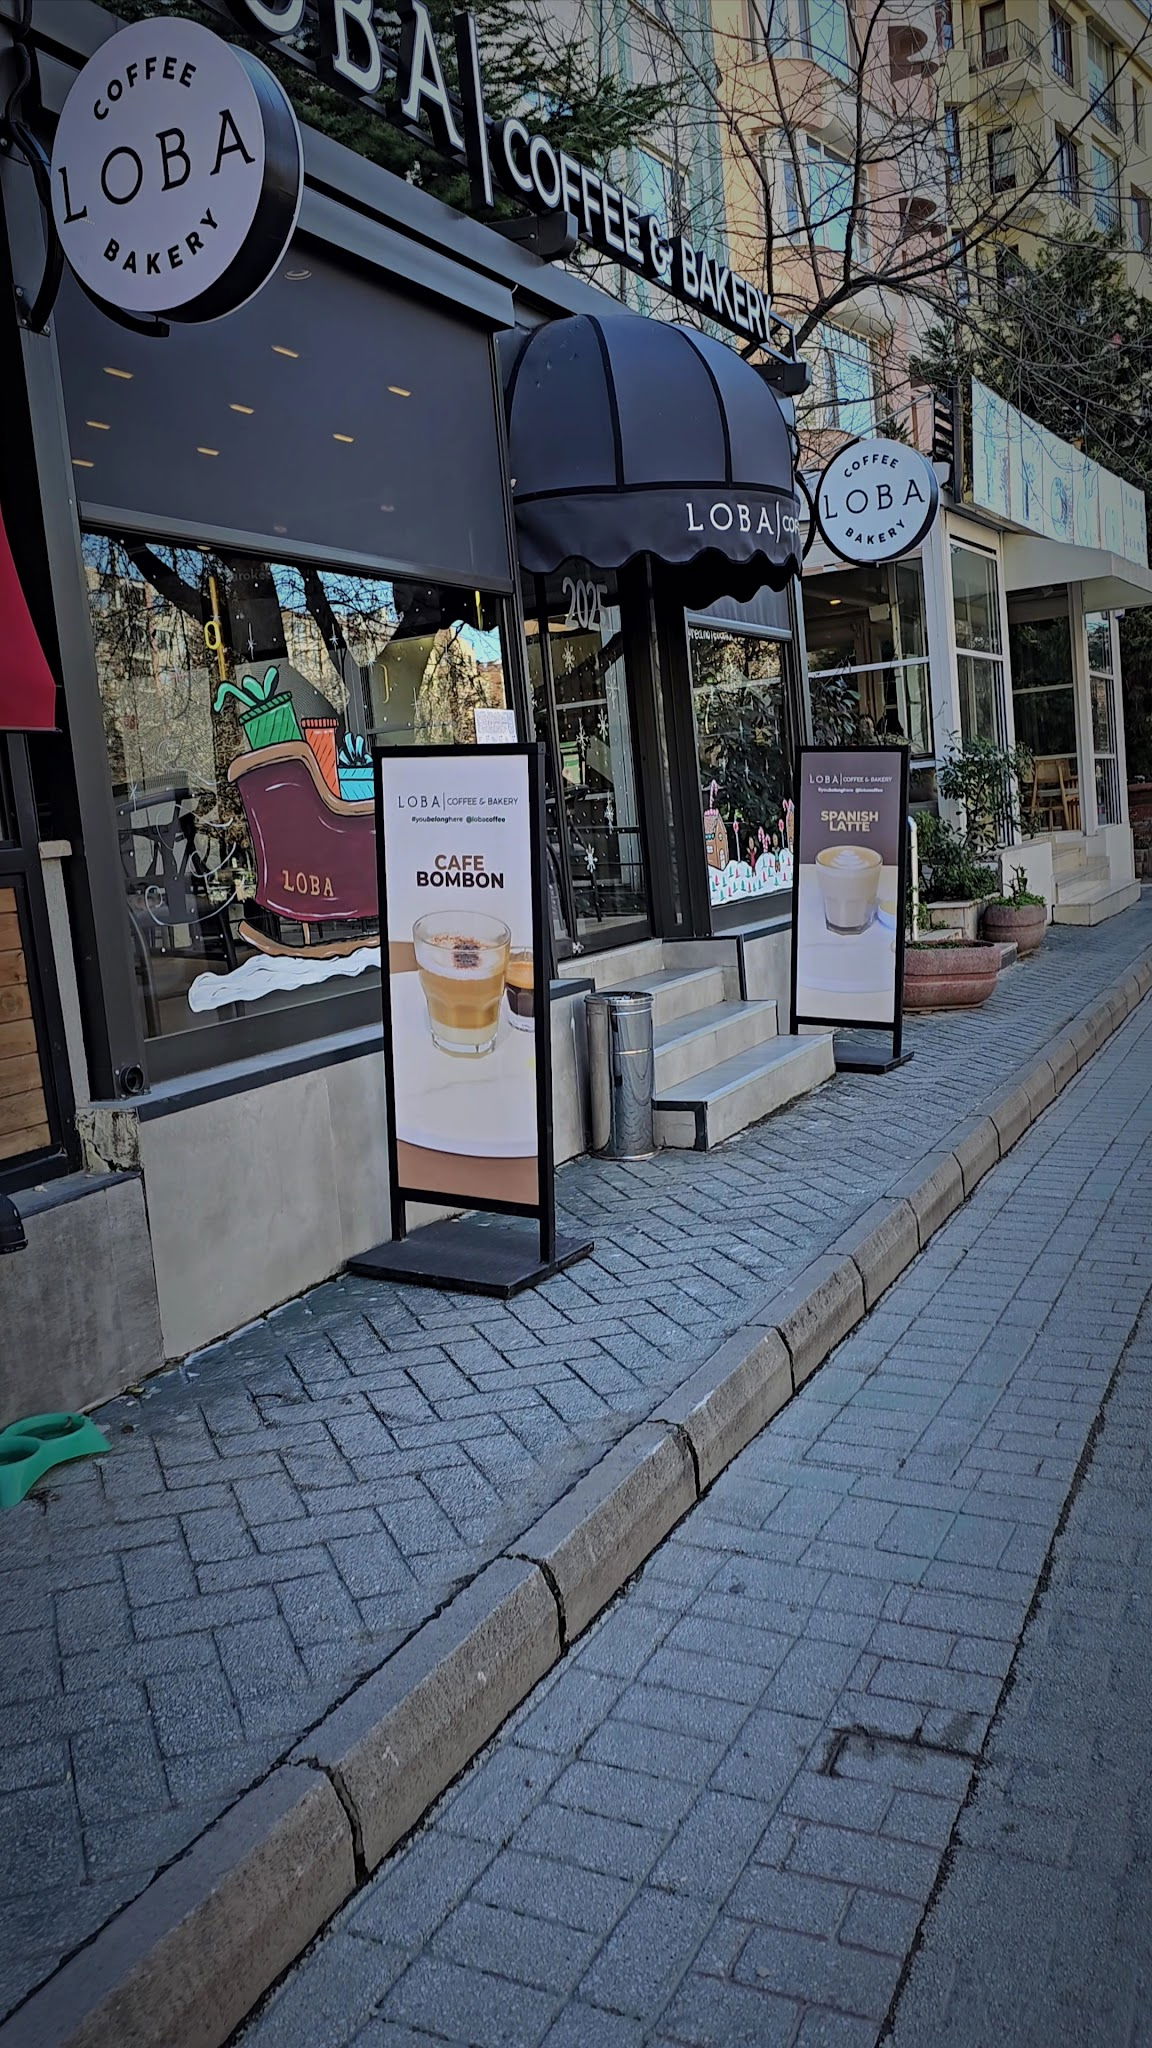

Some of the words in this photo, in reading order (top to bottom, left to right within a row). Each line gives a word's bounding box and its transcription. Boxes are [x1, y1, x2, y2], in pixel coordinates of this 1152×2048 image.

[93, 55, 197, 121] COFFEE
[57, 108, 256, 225] LOBA
[244, 0, 466, 153] BA
[502, 116, 645, 265] COFFEE
[649, 213, 673, 275] &
[680, 235, 772, 342] BAKERY
[103, 207, 219, 276] BAKERY
[843, 453, 899, 478] COFFEE
[823, 478, 926, 520] LOBA
[685, 502, 775, 536] LOBA
[845, 519, 905, 545] BAKERY
[562, 576, 608, 634] 2025
[809, 773, 839, 784] LOBA
[398, 795, 441, 809] LOBA
[446, 797, 477, 806] COFFEE
[478, 797, 486, 806] &
[487, 797, 519, 806] BAKERY
[411, 816, 463, 824] #youbelonghere
[465, 815, 506, 824] @lobacoffee
[820, 810, 879, 822] SPANISH
[829, 821, 870, 832] LATTE
[434, 854, 485, 871] CAFE
[282, 870, 334, 897] LOBA
[416, 871, 505, 889] BOMBON
